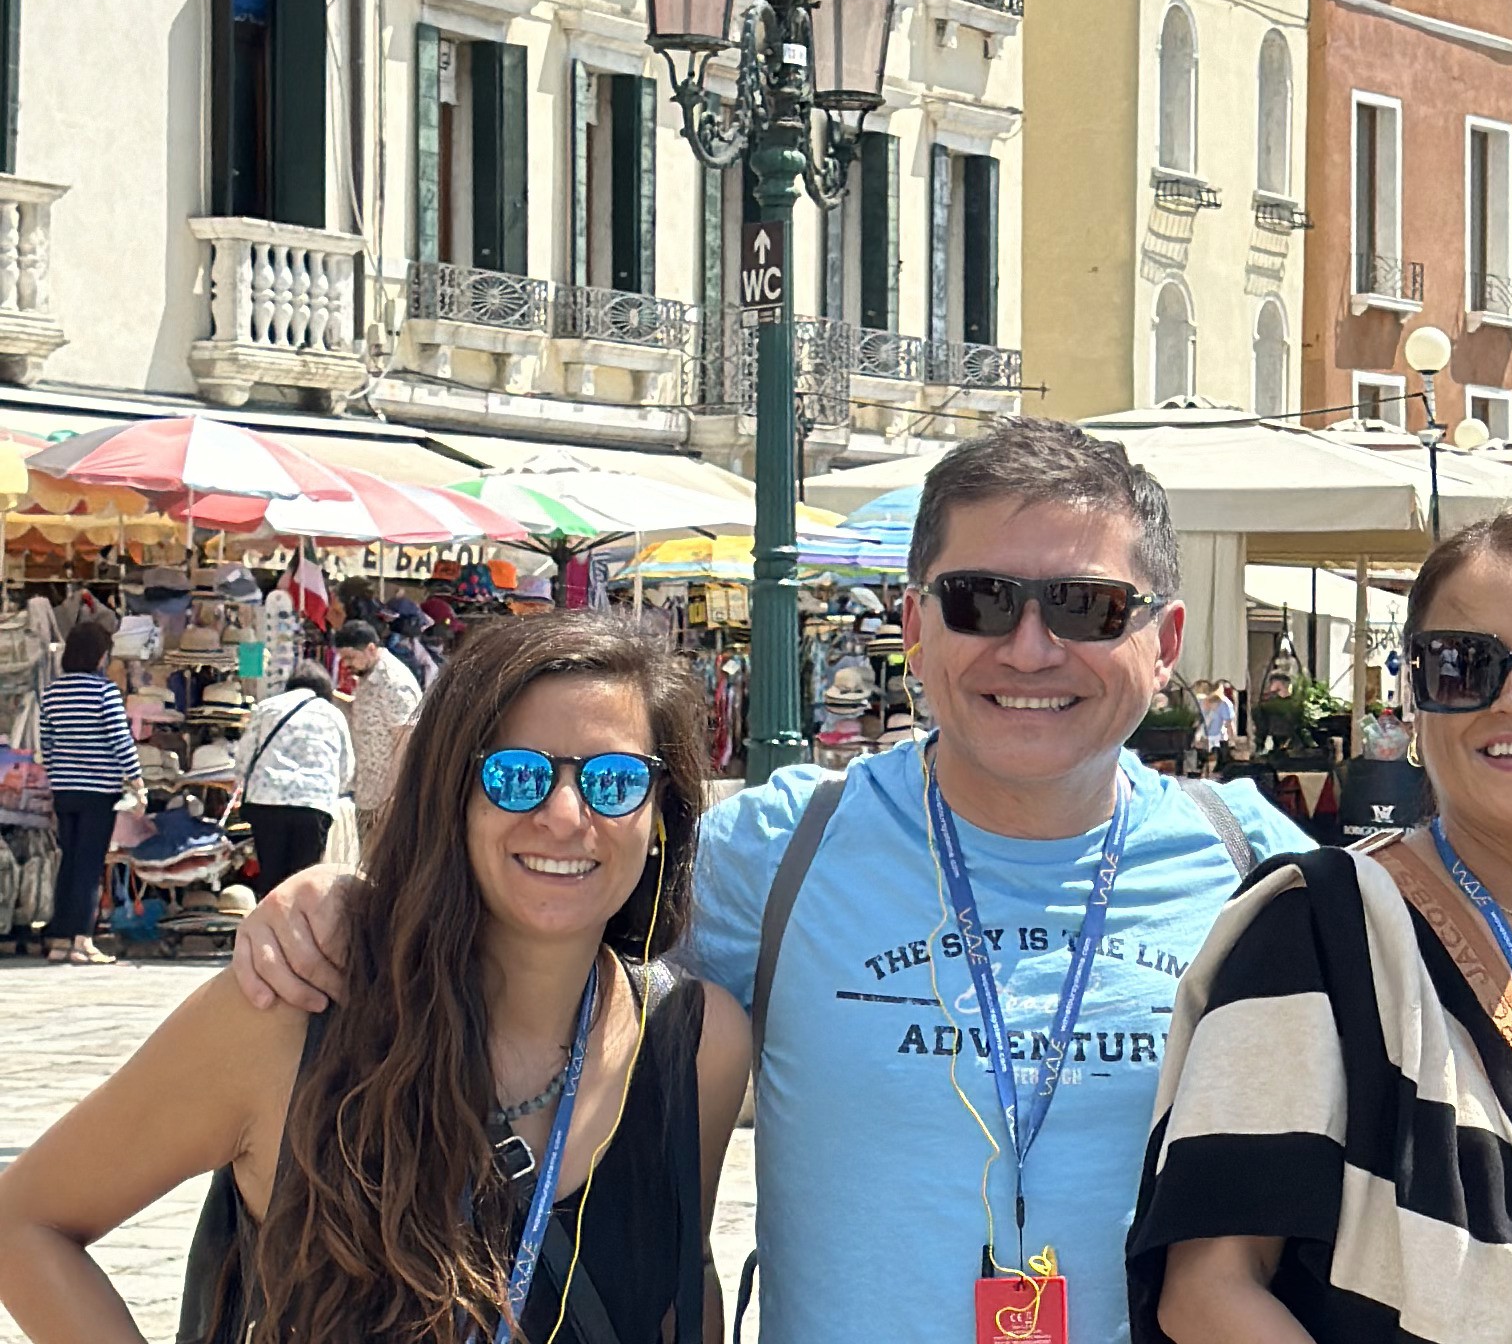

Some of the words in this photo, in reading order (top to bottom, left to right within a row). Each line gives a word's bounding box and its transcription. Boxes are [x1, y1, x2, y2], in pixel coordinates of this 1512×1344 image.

[742, 266, 782, 303] WC
[1452, 858, 1494, 907] WAVE
[865, 939, 931, 981] THE
[941, 928, 1004, 958] SY
[1018, 927, 1049, 951] IS
[1062, 929, 1125, 961] TE
[959, 907, 989, 965] WAVE
[897, 1023, 1168, 1063] ADVENTUR
